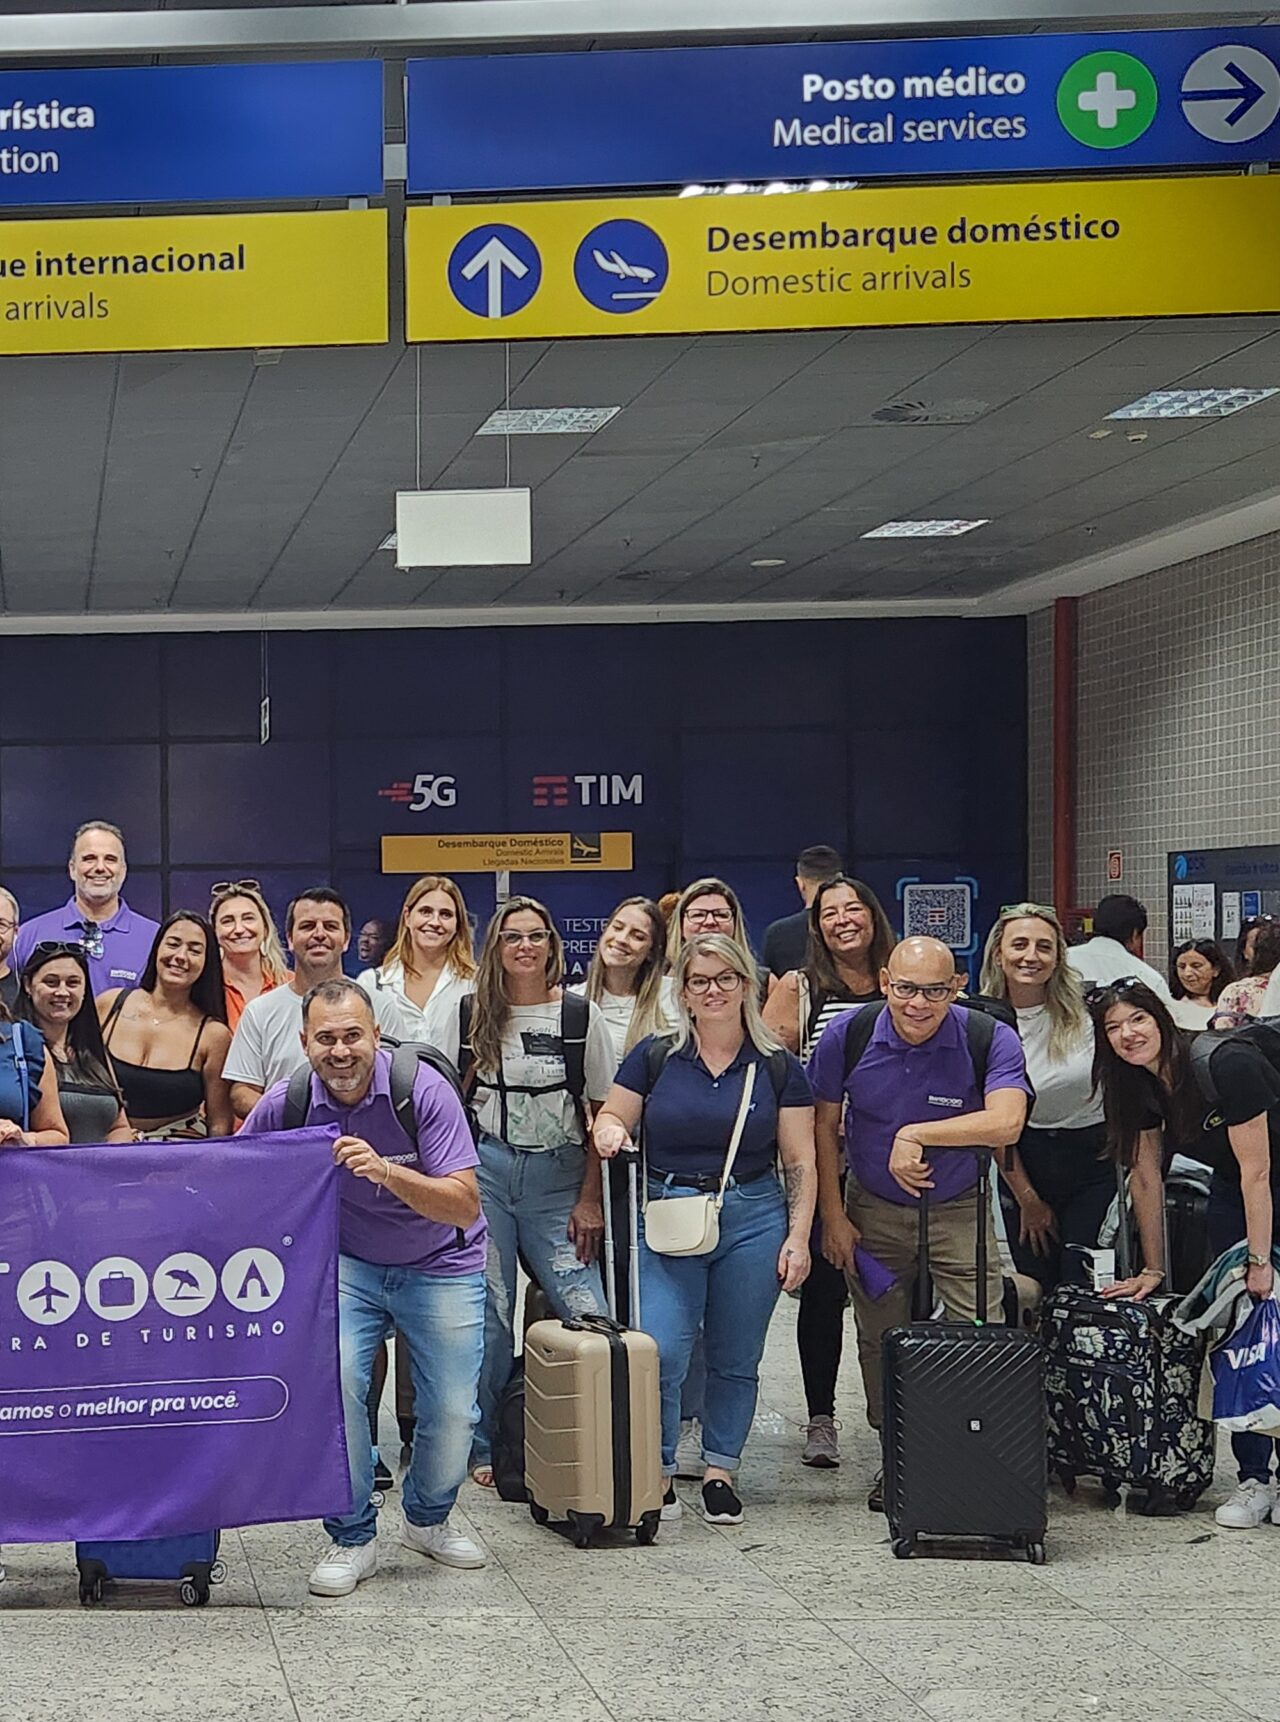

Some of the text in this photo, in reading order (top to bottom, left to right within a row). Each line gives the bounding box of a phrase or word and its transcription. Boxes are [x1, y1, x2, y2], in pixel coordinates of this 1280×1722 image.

[802, 66, 1026, 102] Posto médico
[773, 112, 1027, 147] Medical services
[706, 213, 1121, 254] Desembarque doméstico
[35, 244, 246, 278] internacional
[707, 261, 972, 297] Domestic arrivals
[4, 291, 110, 322] arrivals
[408, 774, 457, 811] 5G
[574, 774, 643, 805] TIM
[438, 836, 564, 849] Desembarque Doméstico
[496, 849, 531, 857] Domestic
[76, 1331, 112, 1349] DE
[140, 1320, 286, 1344] TURISMO
[1222, 1342, 1267, 1370] VISA
[58, 1403, 72, 1418] o
[75, 1394, 149, 1417] melhor
[149, 1396, 186, 1417] pra
[189, 1390, 240, 1412] você.
